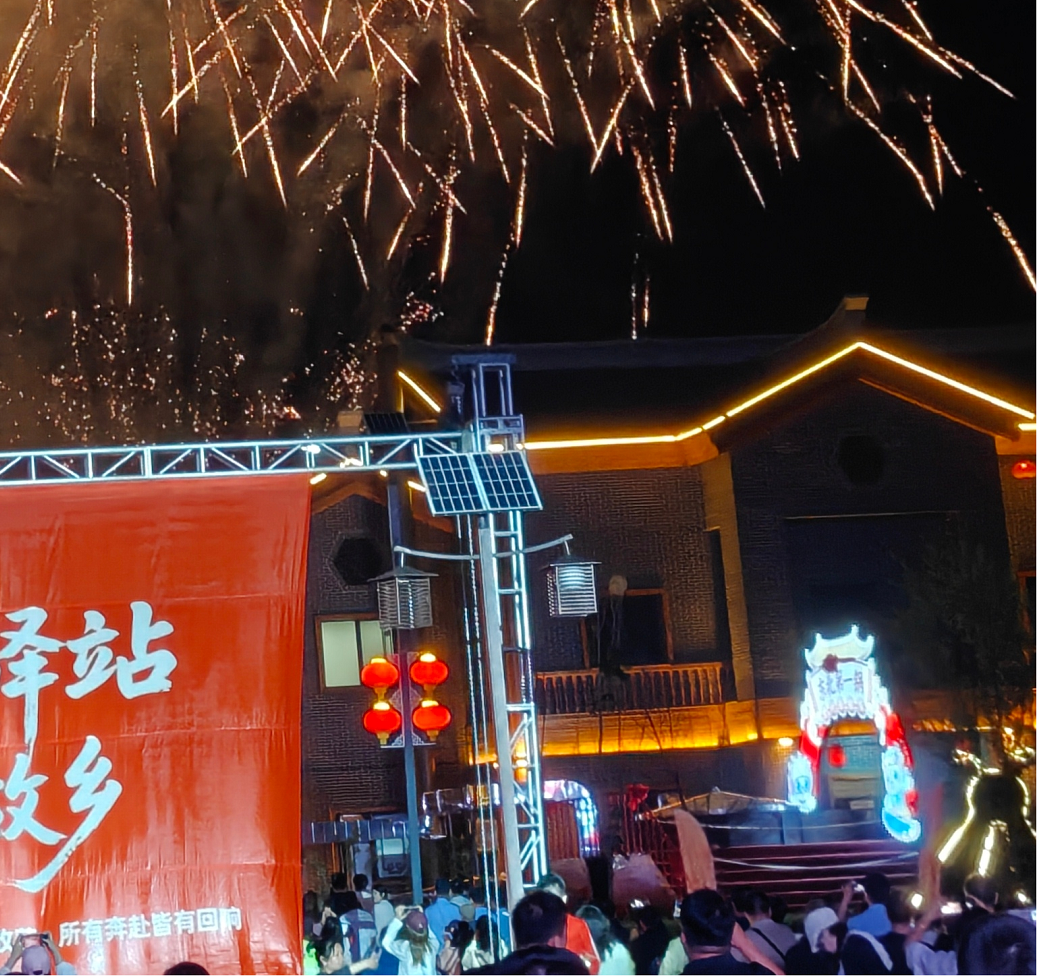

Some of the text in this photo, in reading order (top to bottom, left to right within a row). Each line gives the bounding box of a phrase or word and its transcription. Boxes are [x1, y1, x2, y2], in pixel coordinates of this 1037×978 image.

[58, 905, 243, 948] 所有奔赴皆有回响
